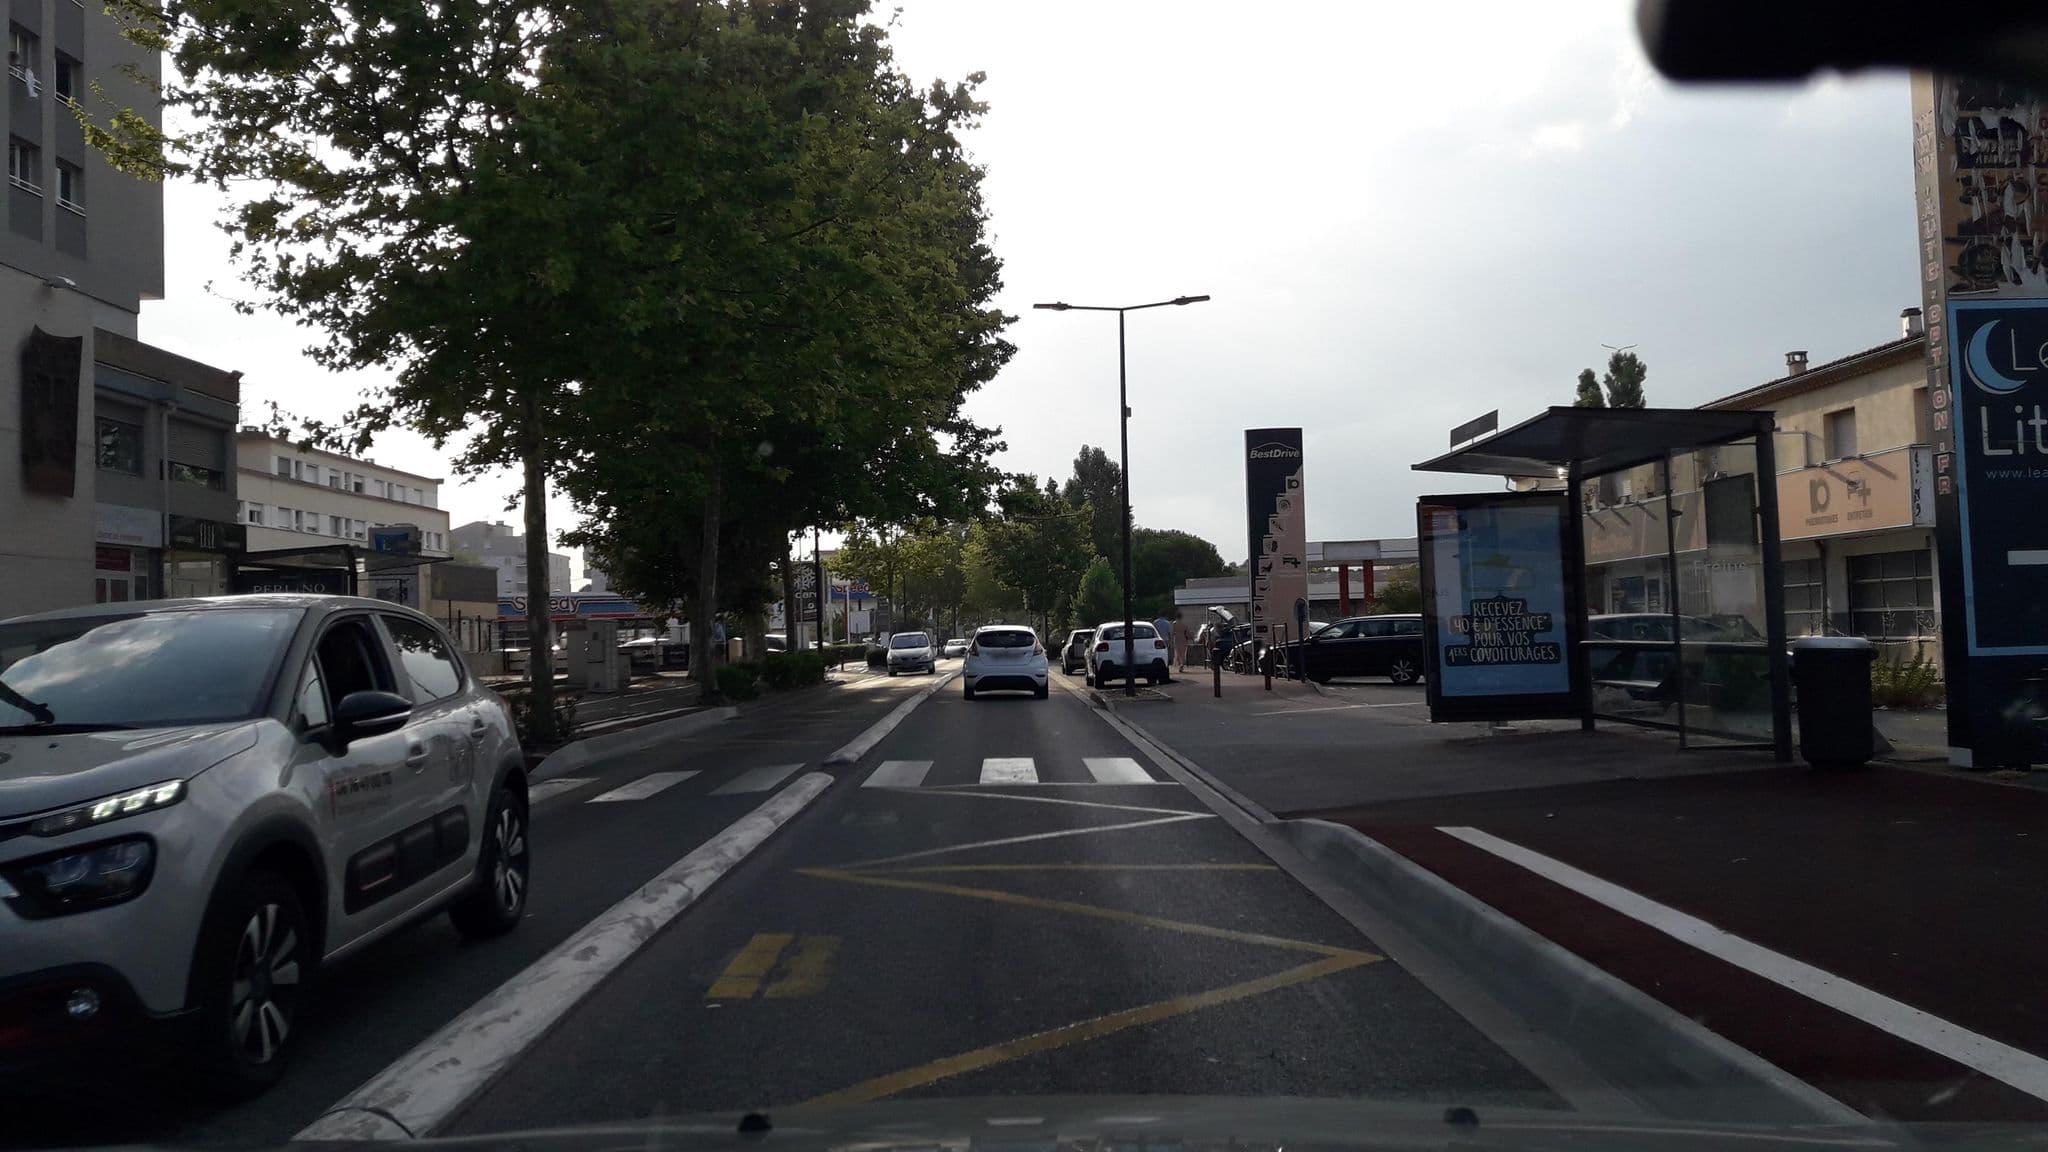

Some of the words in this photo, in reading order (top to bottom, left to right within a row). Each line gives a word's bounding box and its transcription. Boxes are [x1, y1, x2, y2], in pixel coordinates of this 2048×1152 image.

[1250, 449, 1300, 459] BestDrive
[514, 595, 578, 614] Sedy
[1473, 602, 1523, 616] RECEVEZ
[1454, 618, 1470, 633] 40
[1472, 618, 1481, 632] €
[1474, 632, 1505, 647] POUR
[1507, 631, 1530, 646] VOS
